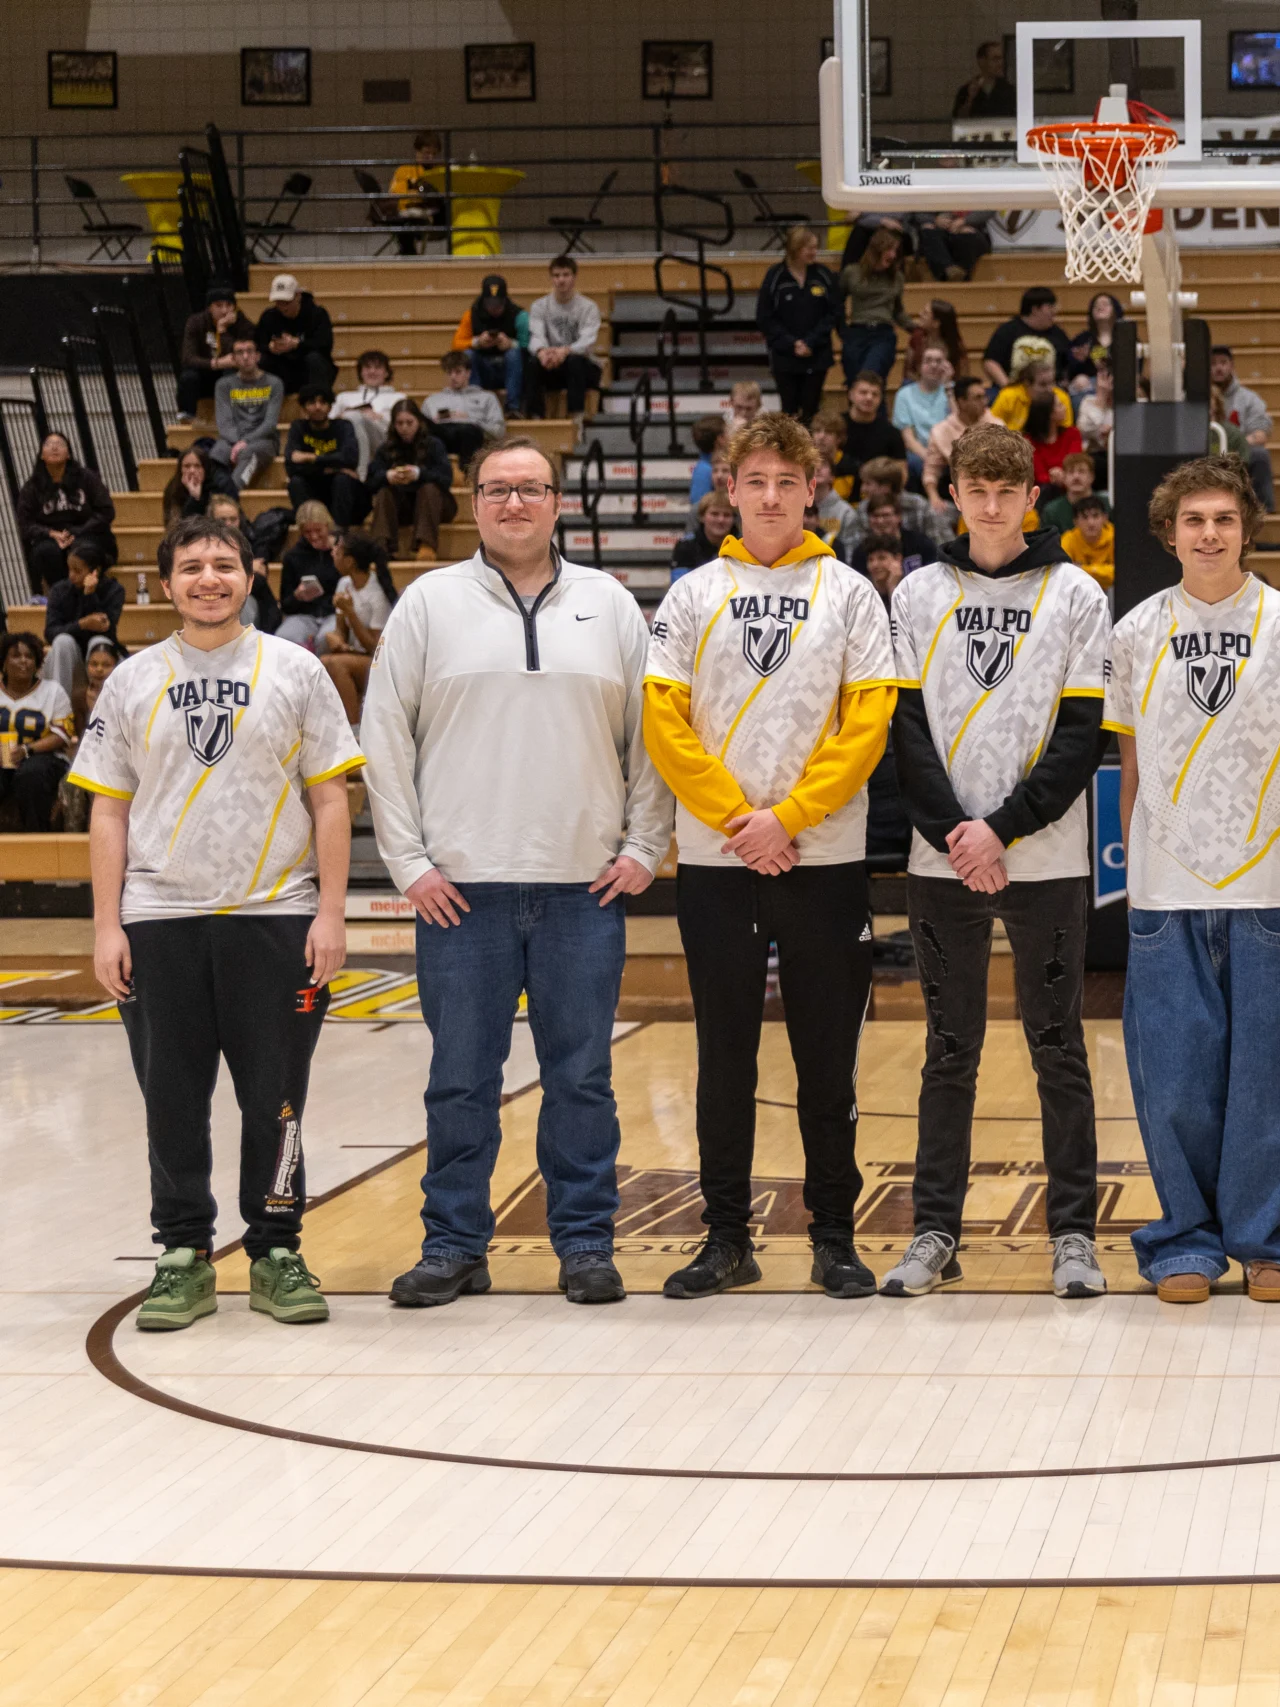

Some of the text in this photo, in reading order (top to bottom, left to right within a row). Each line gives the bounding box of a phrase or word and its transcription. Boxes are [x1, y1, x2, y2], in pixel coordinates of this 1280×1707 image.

[859, 175, 911, 186] SPALDING
[729, 594, 810, 621] VALPO
[954, 607, 1032, 633] VALPO
[1171, 632, 1251, 660] VALPO
[167, 679, 251, 710] VALPO
[370, 901, 414, 916] meijer
[274, 1120, 297, 1196] GAMERS
